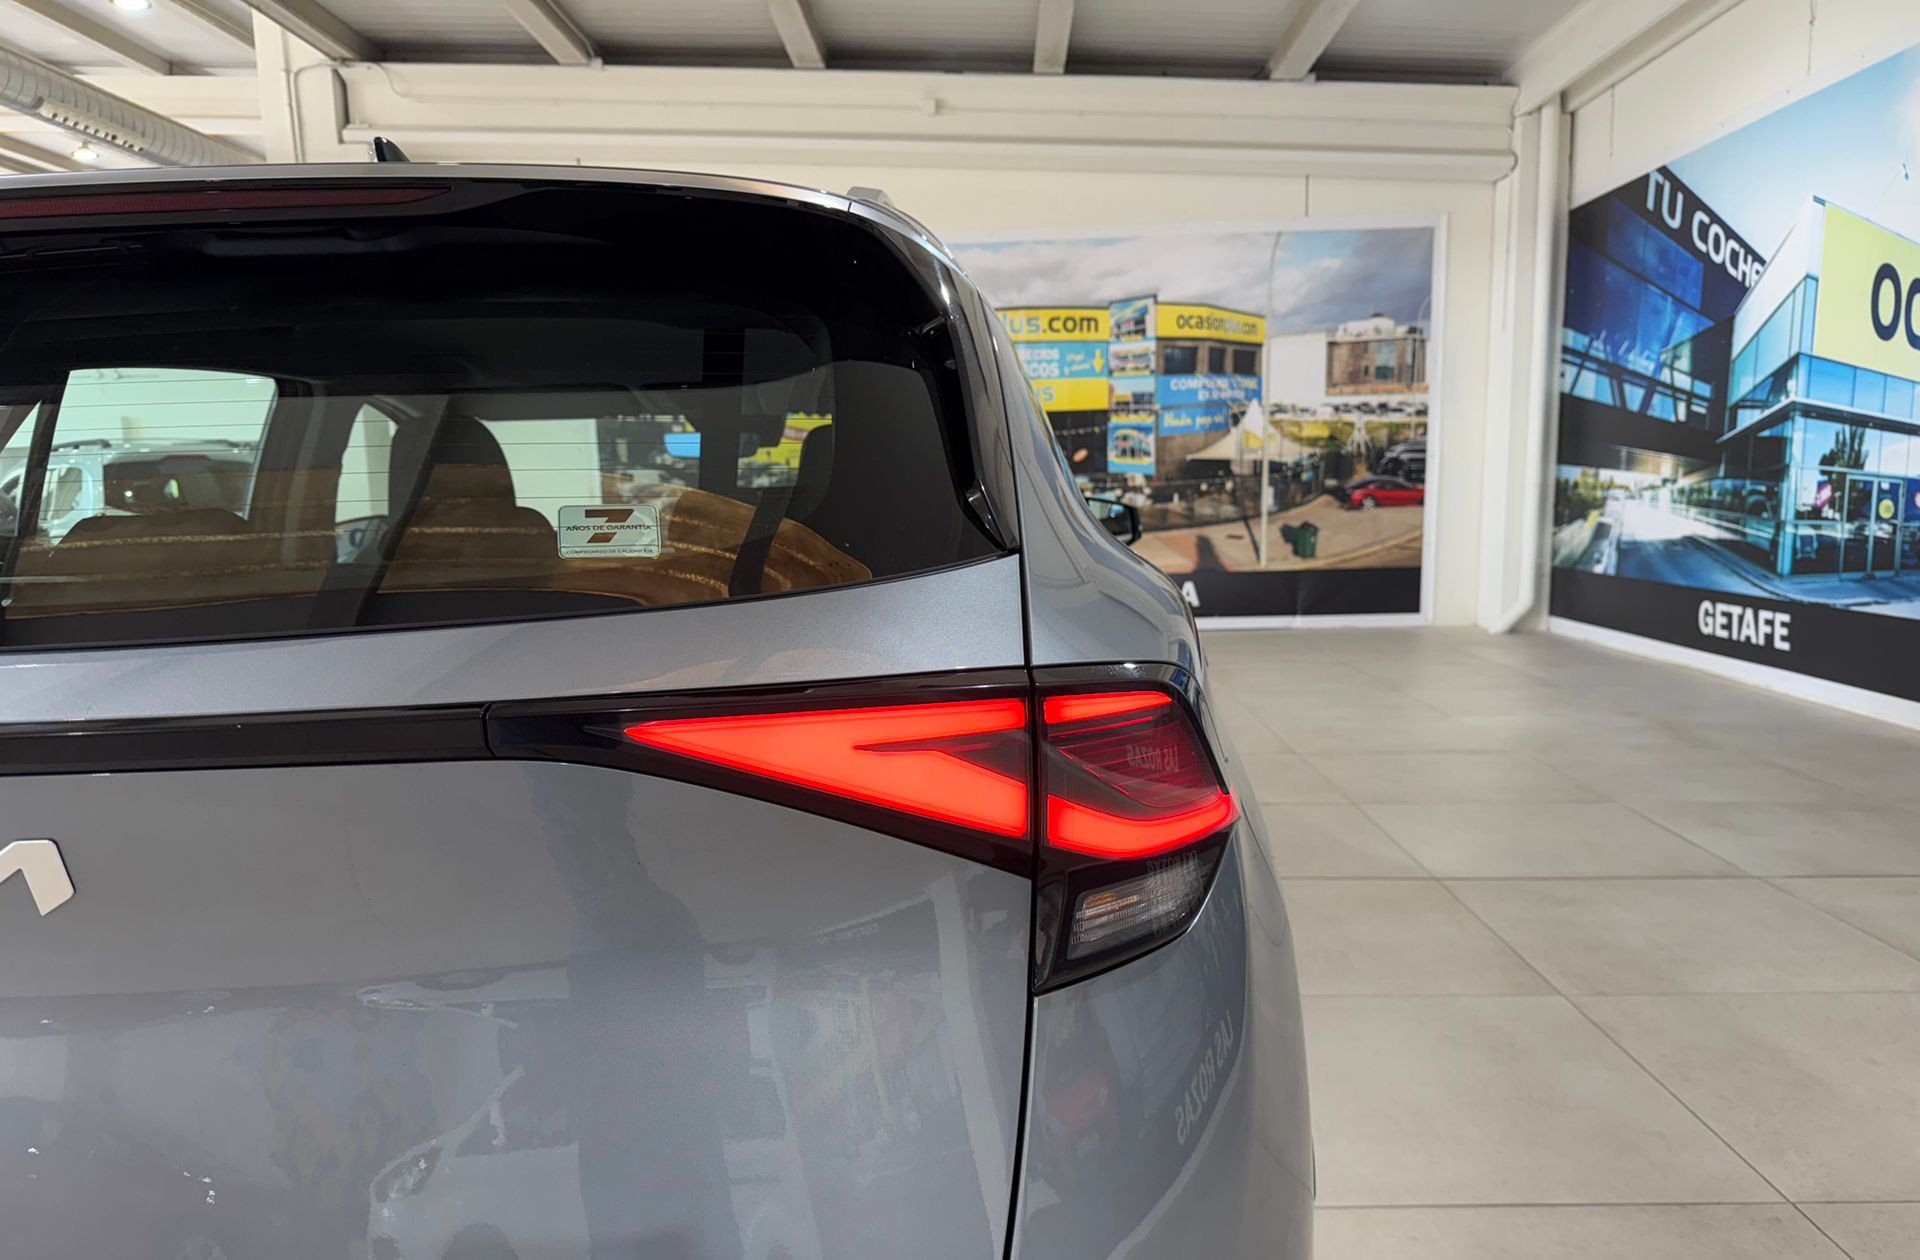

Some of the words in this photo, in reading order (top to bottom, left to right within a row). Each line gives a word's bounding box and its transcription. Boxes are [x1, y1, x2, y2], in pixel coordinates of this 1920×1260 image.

[1646, 171, 1684, 229] TU
[606, 523, 652, 531] GARANTÍA
[1698, 600, 1791, 651] GETAFE
